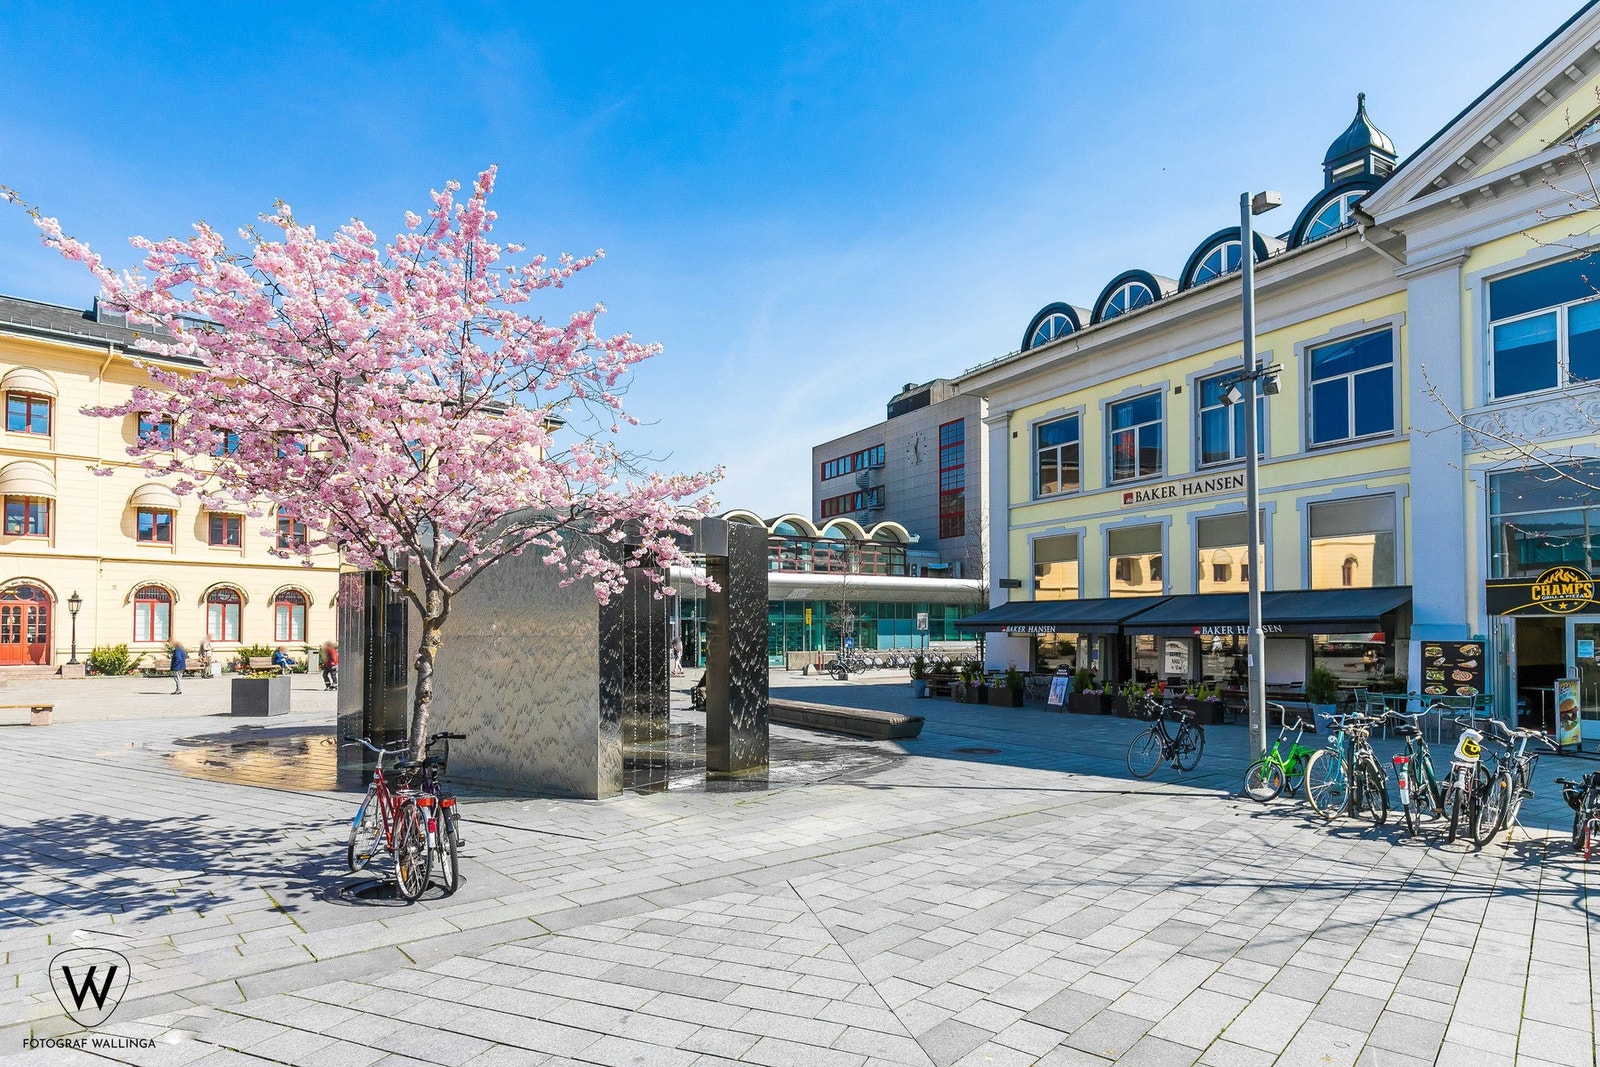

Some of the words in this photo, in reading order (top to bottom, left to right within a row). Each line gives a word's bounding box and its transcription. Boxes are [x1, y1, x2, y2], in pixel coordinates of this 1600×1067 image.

[1135, 485, 1178, 503] BAKER
[1182, 474, 1244, 496] HANSEN
[1531, 582, 1593, 601] CHAMPS
[1006, 625, 1026, 633] BAKER
[1028, 625, 1056, 633] HANSEN
[1202, 626, 1234, 635] BAKER
[1237, 624, 1283, 635] HASEN
